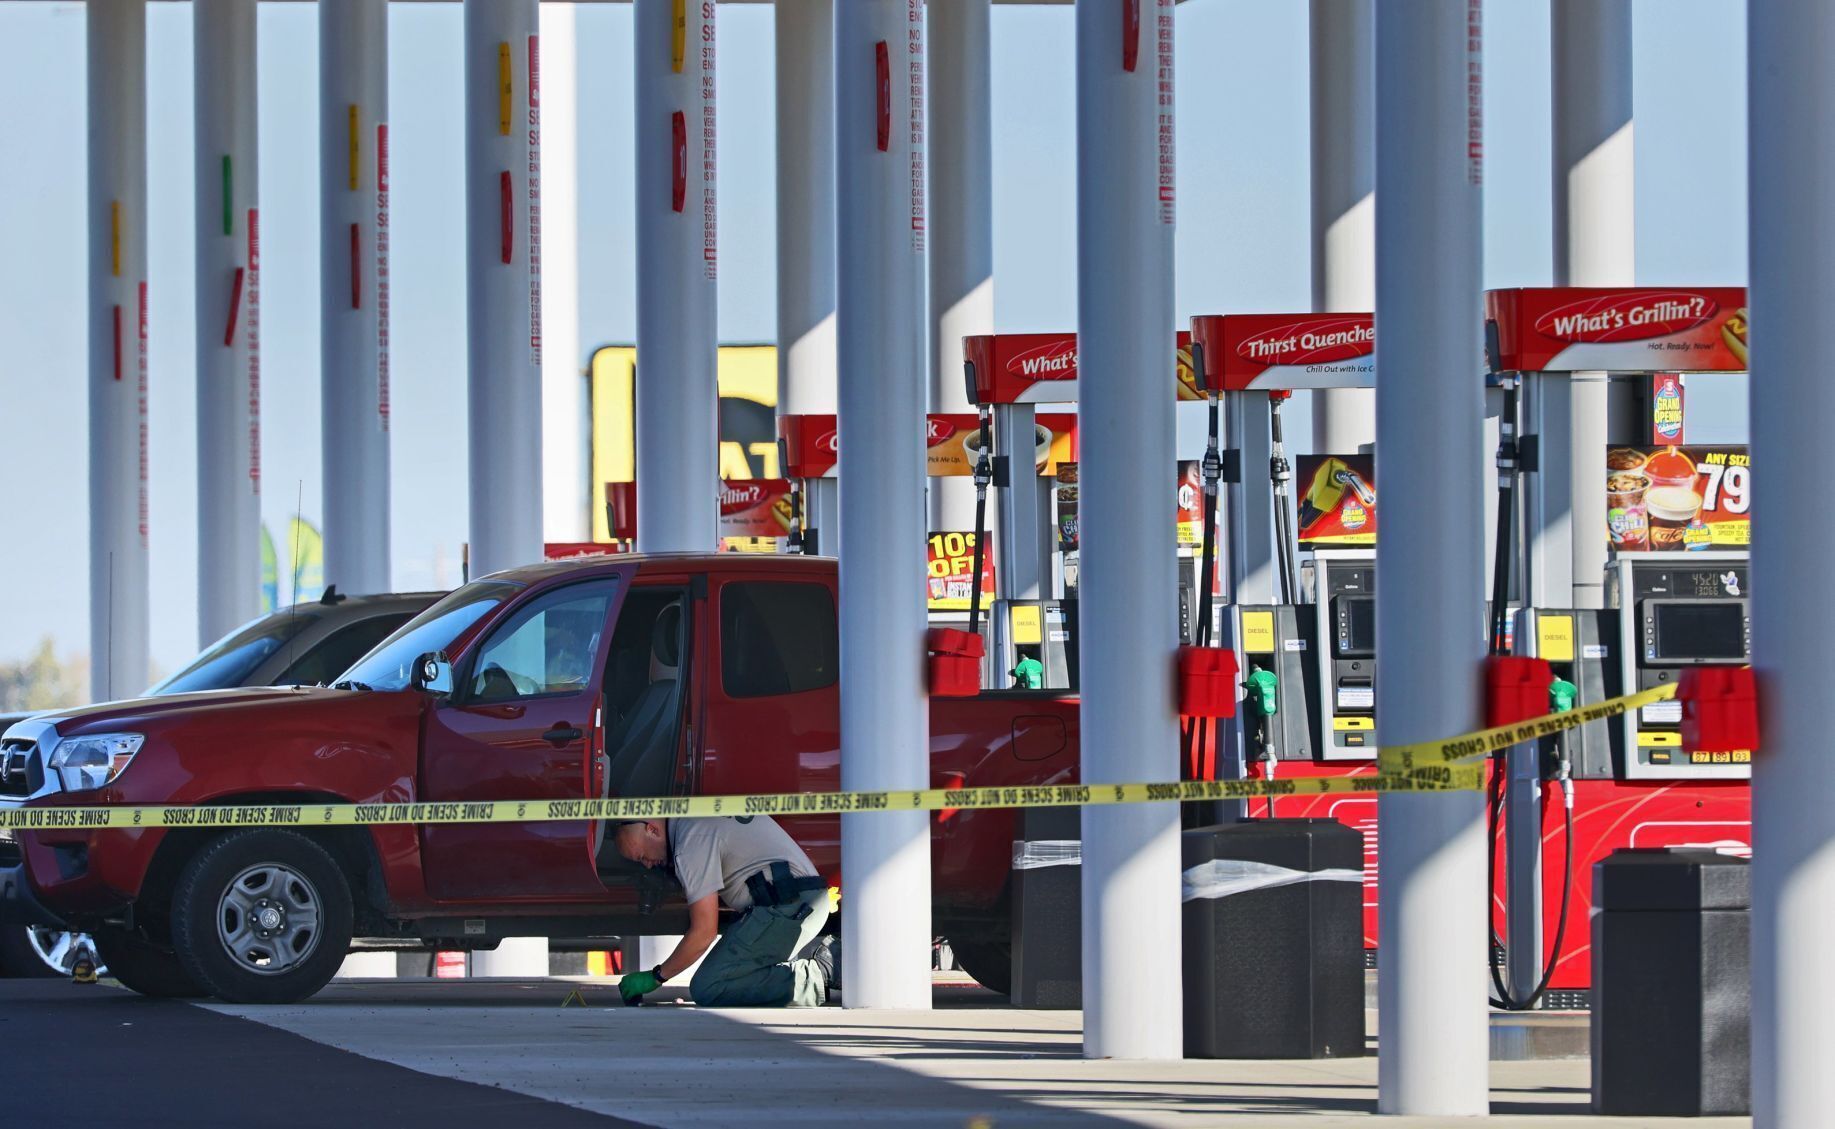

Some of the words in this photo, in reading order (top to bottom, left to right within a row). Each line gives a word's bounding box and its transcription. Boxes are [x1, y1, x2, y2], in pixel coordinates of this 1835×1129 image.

[909, 29, 921, 41] NO
[703, 76, 714, 87] NO
[1553, 309, 1623, 337] What's
[1627, 297, 1705, 324] Grillin'?
[1247, 336, 1297, 359] Thirst
[1647, 342, 1664, 350] Hot.
[1022, 352, 1078, 375] What's
[1305, 365, 1322, 373] Chill
[1324, 365, 1338, 373] Out
[1339, 365, 1355, 373] with
[1357, 365, 1367, 373] Ice
[1657, 397, 1680, 410] GRAND
[1705, 453, 1728, 465] ANY
[1584, 702, 1626, 720] CRIME
[1538, 715, 1580, 736] SCENE
[1488, 731, 1514, 751] NOT
[1518, 727, 1536, 746] DO
[1442, 736, 1486, 761] CROSS
[1695, 753, 1707, 762] 87
[1715, 752, 1728, 762] 89
[1735, 753, 1747, 762] 93
[820, 794, 852, 809] SCENE
[855, 792, 888, 808] CRIME
[945, 790, 978, 806] CROSS
[980, 789, 1001, 804] NOT
[1004, 788, 1018, 804] DO
[1022, 787, 1054, 803] SCENE
[1057, 786, 1090, 802] CRIME
[548, 801, 580, 817] CROSS
[583, 801, 604, 816] NOT
[606, 800, 620, 815] DO
[622, 799, 654, 815] SCENE
[657, 798, 689, 814] CRIME
[746, 796, 778, 811] CROSS
[781, 795, 800, 810] NOT
[803, 795, 816, 810] DO
[8, 811, 28, 827] NOT
[30, 811, 44, 826] DO
[47, 811, 76, 826] SCENE
[79, 810, 110, 825] CRIME
[163, 809, 195, 824] CROSS
[197, 808, 218, 823] NOT
[219, 808, 232, 823] DO
[236, 808, 267, 823] SCENE
[270, 807, 301, 822] CRIME
[355, 806, 386, 821] CROSS
[388, 805, 408, 820] NOT
[411, 805, 424, 820] DO
[428, 804, 458, 819] SCENE
[462, 804, 494, 819] CRIME
